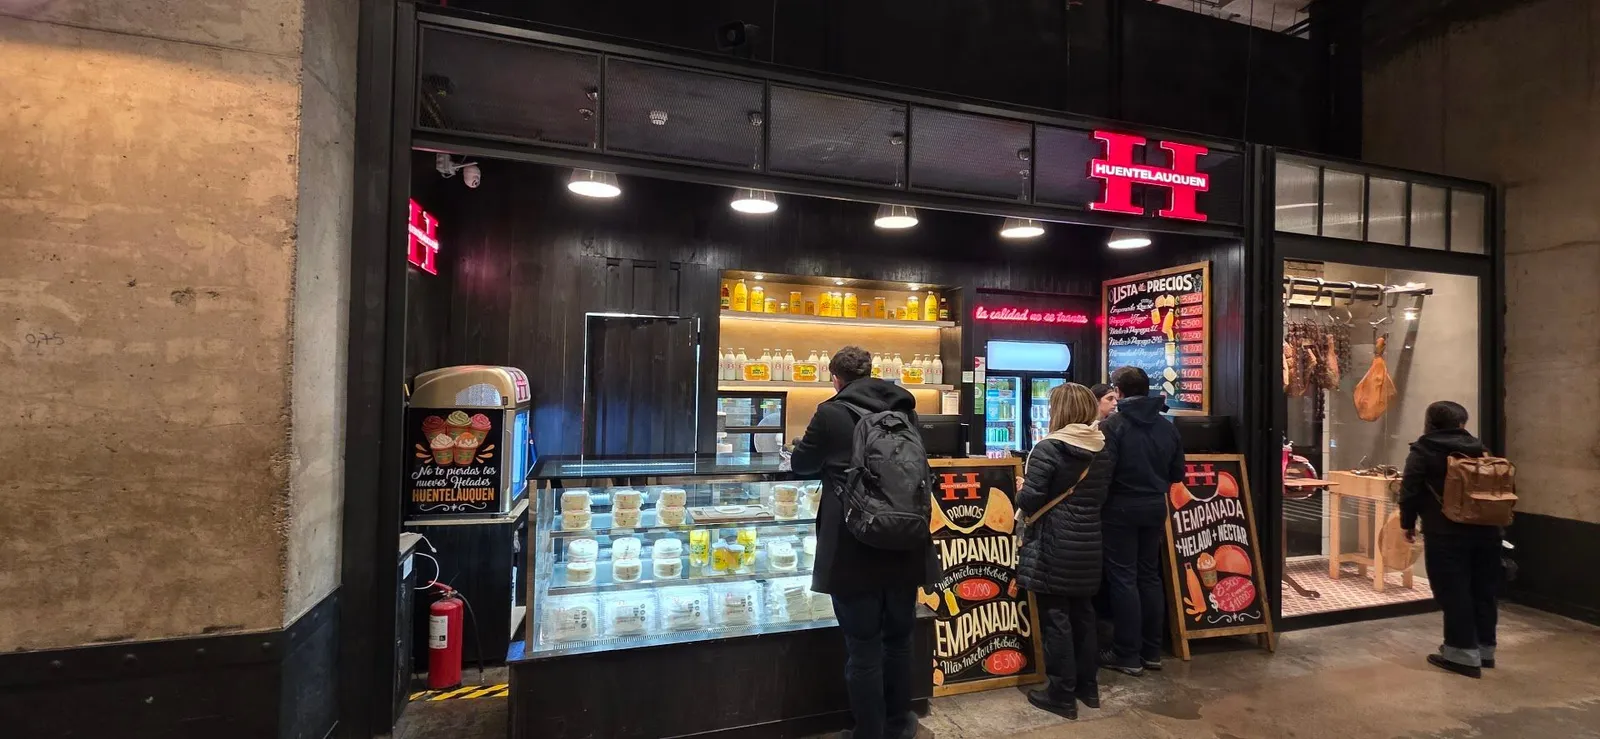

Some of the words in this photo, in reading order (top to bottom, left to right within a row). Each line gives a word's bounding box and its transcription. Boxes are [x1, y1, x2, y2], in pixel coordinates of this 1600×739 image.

[1095, 163, 1206, 188] HUENTELAUQUEN
[1113, 284, 1139, 305] LISTA
[1147, 274, 1193, 293] PRECIOS
[989, 307, 1029, 320] calidad
[411, 465, 433, 479] No
[435, 466, 445, 476] te
[446, 466, 480, 479] pierdas
[482, 465, 497, 475] los
[416, 479, 447, 487] nuevos
[450, 475, 492, 489] Helados
[412, 487, 495, 503] HUENTELAUQUEN
[946, 504, 985, 522] PROMOS
[1217, 519, 1249, 546] NÉCTAR
[933, 535, 1020, 571] MPANADA
[935, 601, 1031, 657] EMPANADAS
